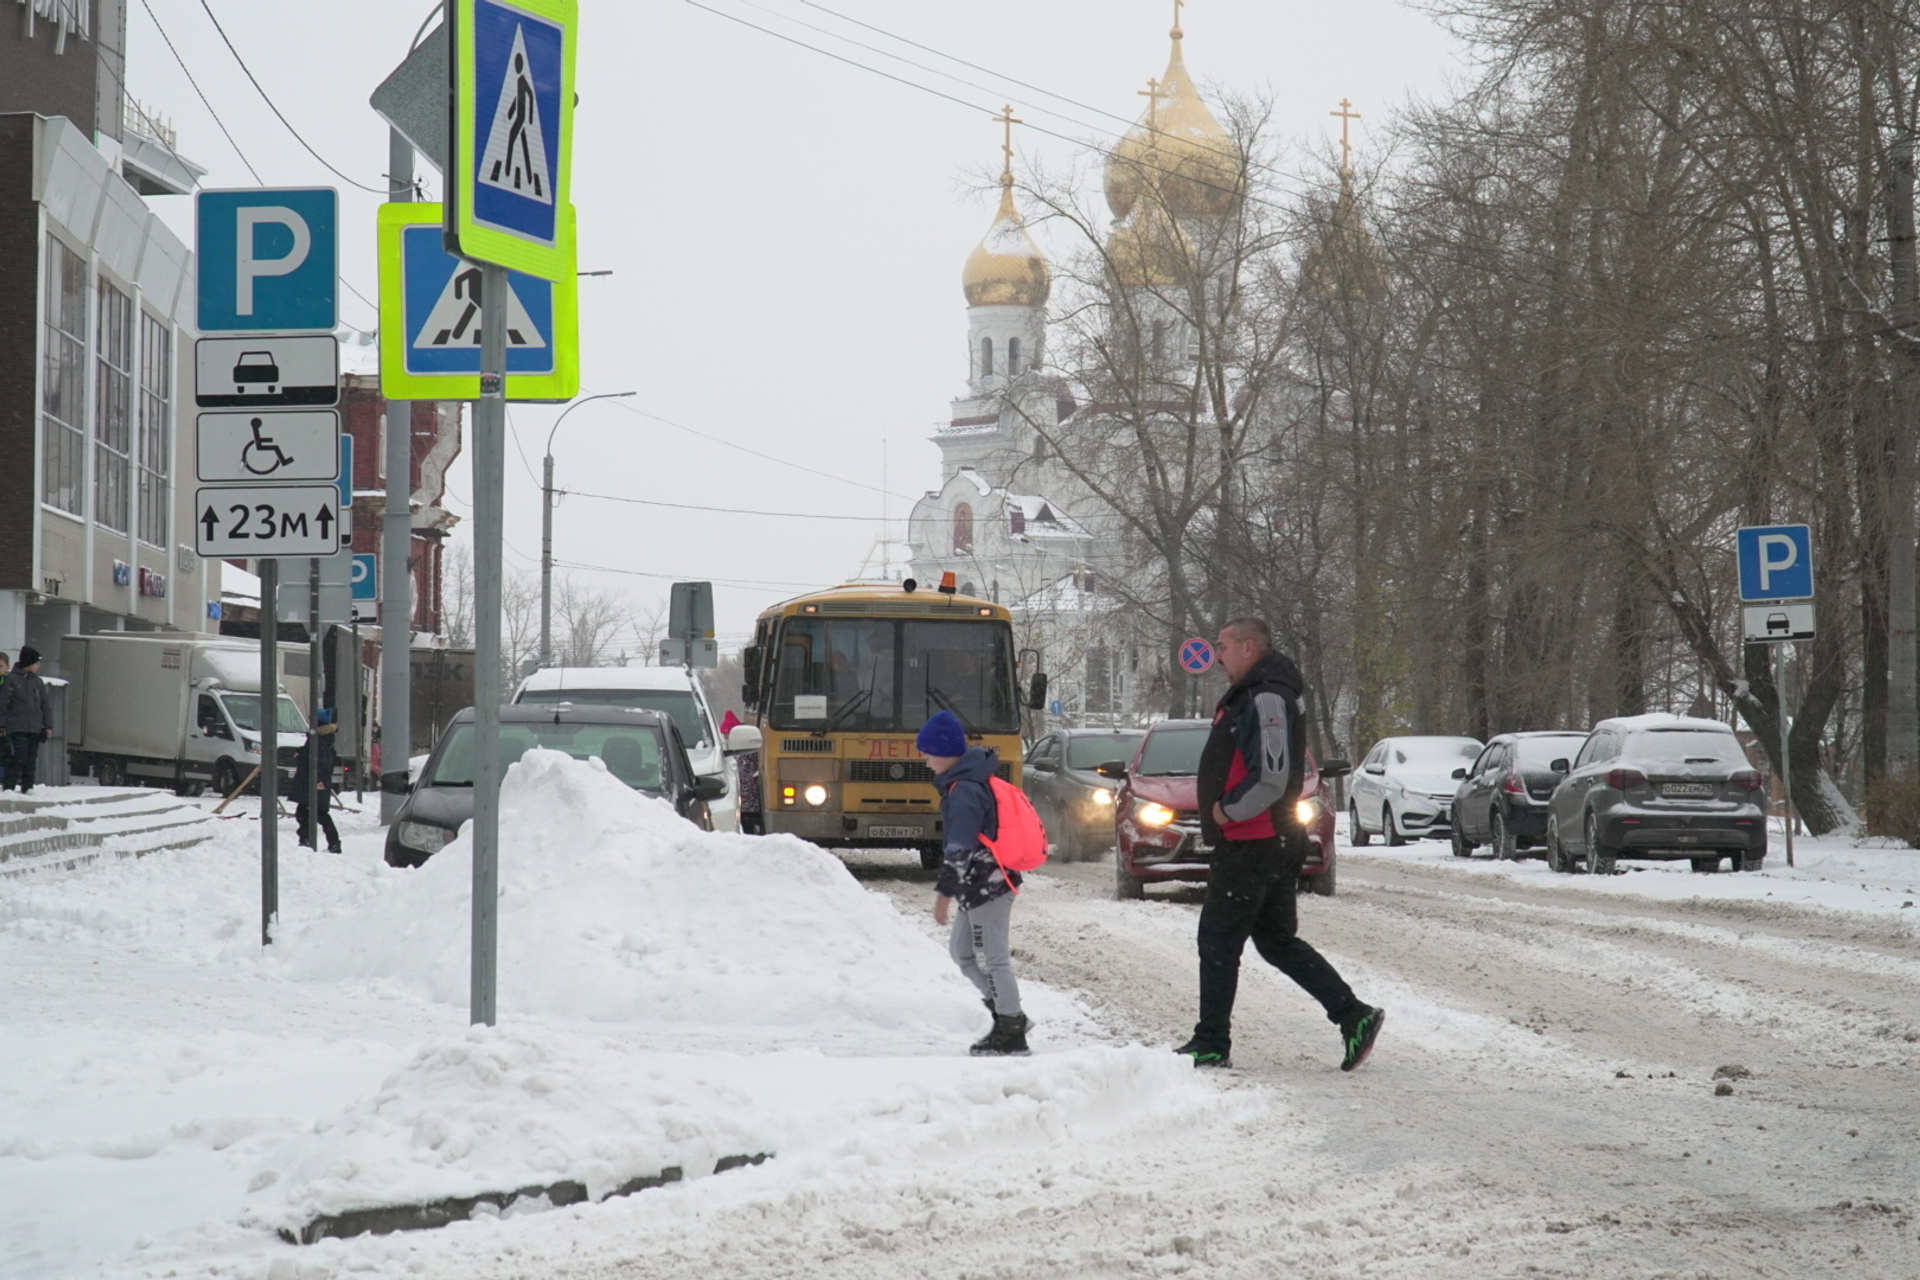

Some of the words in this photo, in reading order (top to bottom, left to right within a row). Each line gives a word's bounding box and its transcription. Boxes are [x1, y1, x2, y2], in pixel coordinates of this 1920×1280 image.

[236, 206, 310, 315] P
[1758, 534, 1797, 590] P
[868, 739, 923, 759] ДЕТ
[973, 924, 983, 947] ONLY
